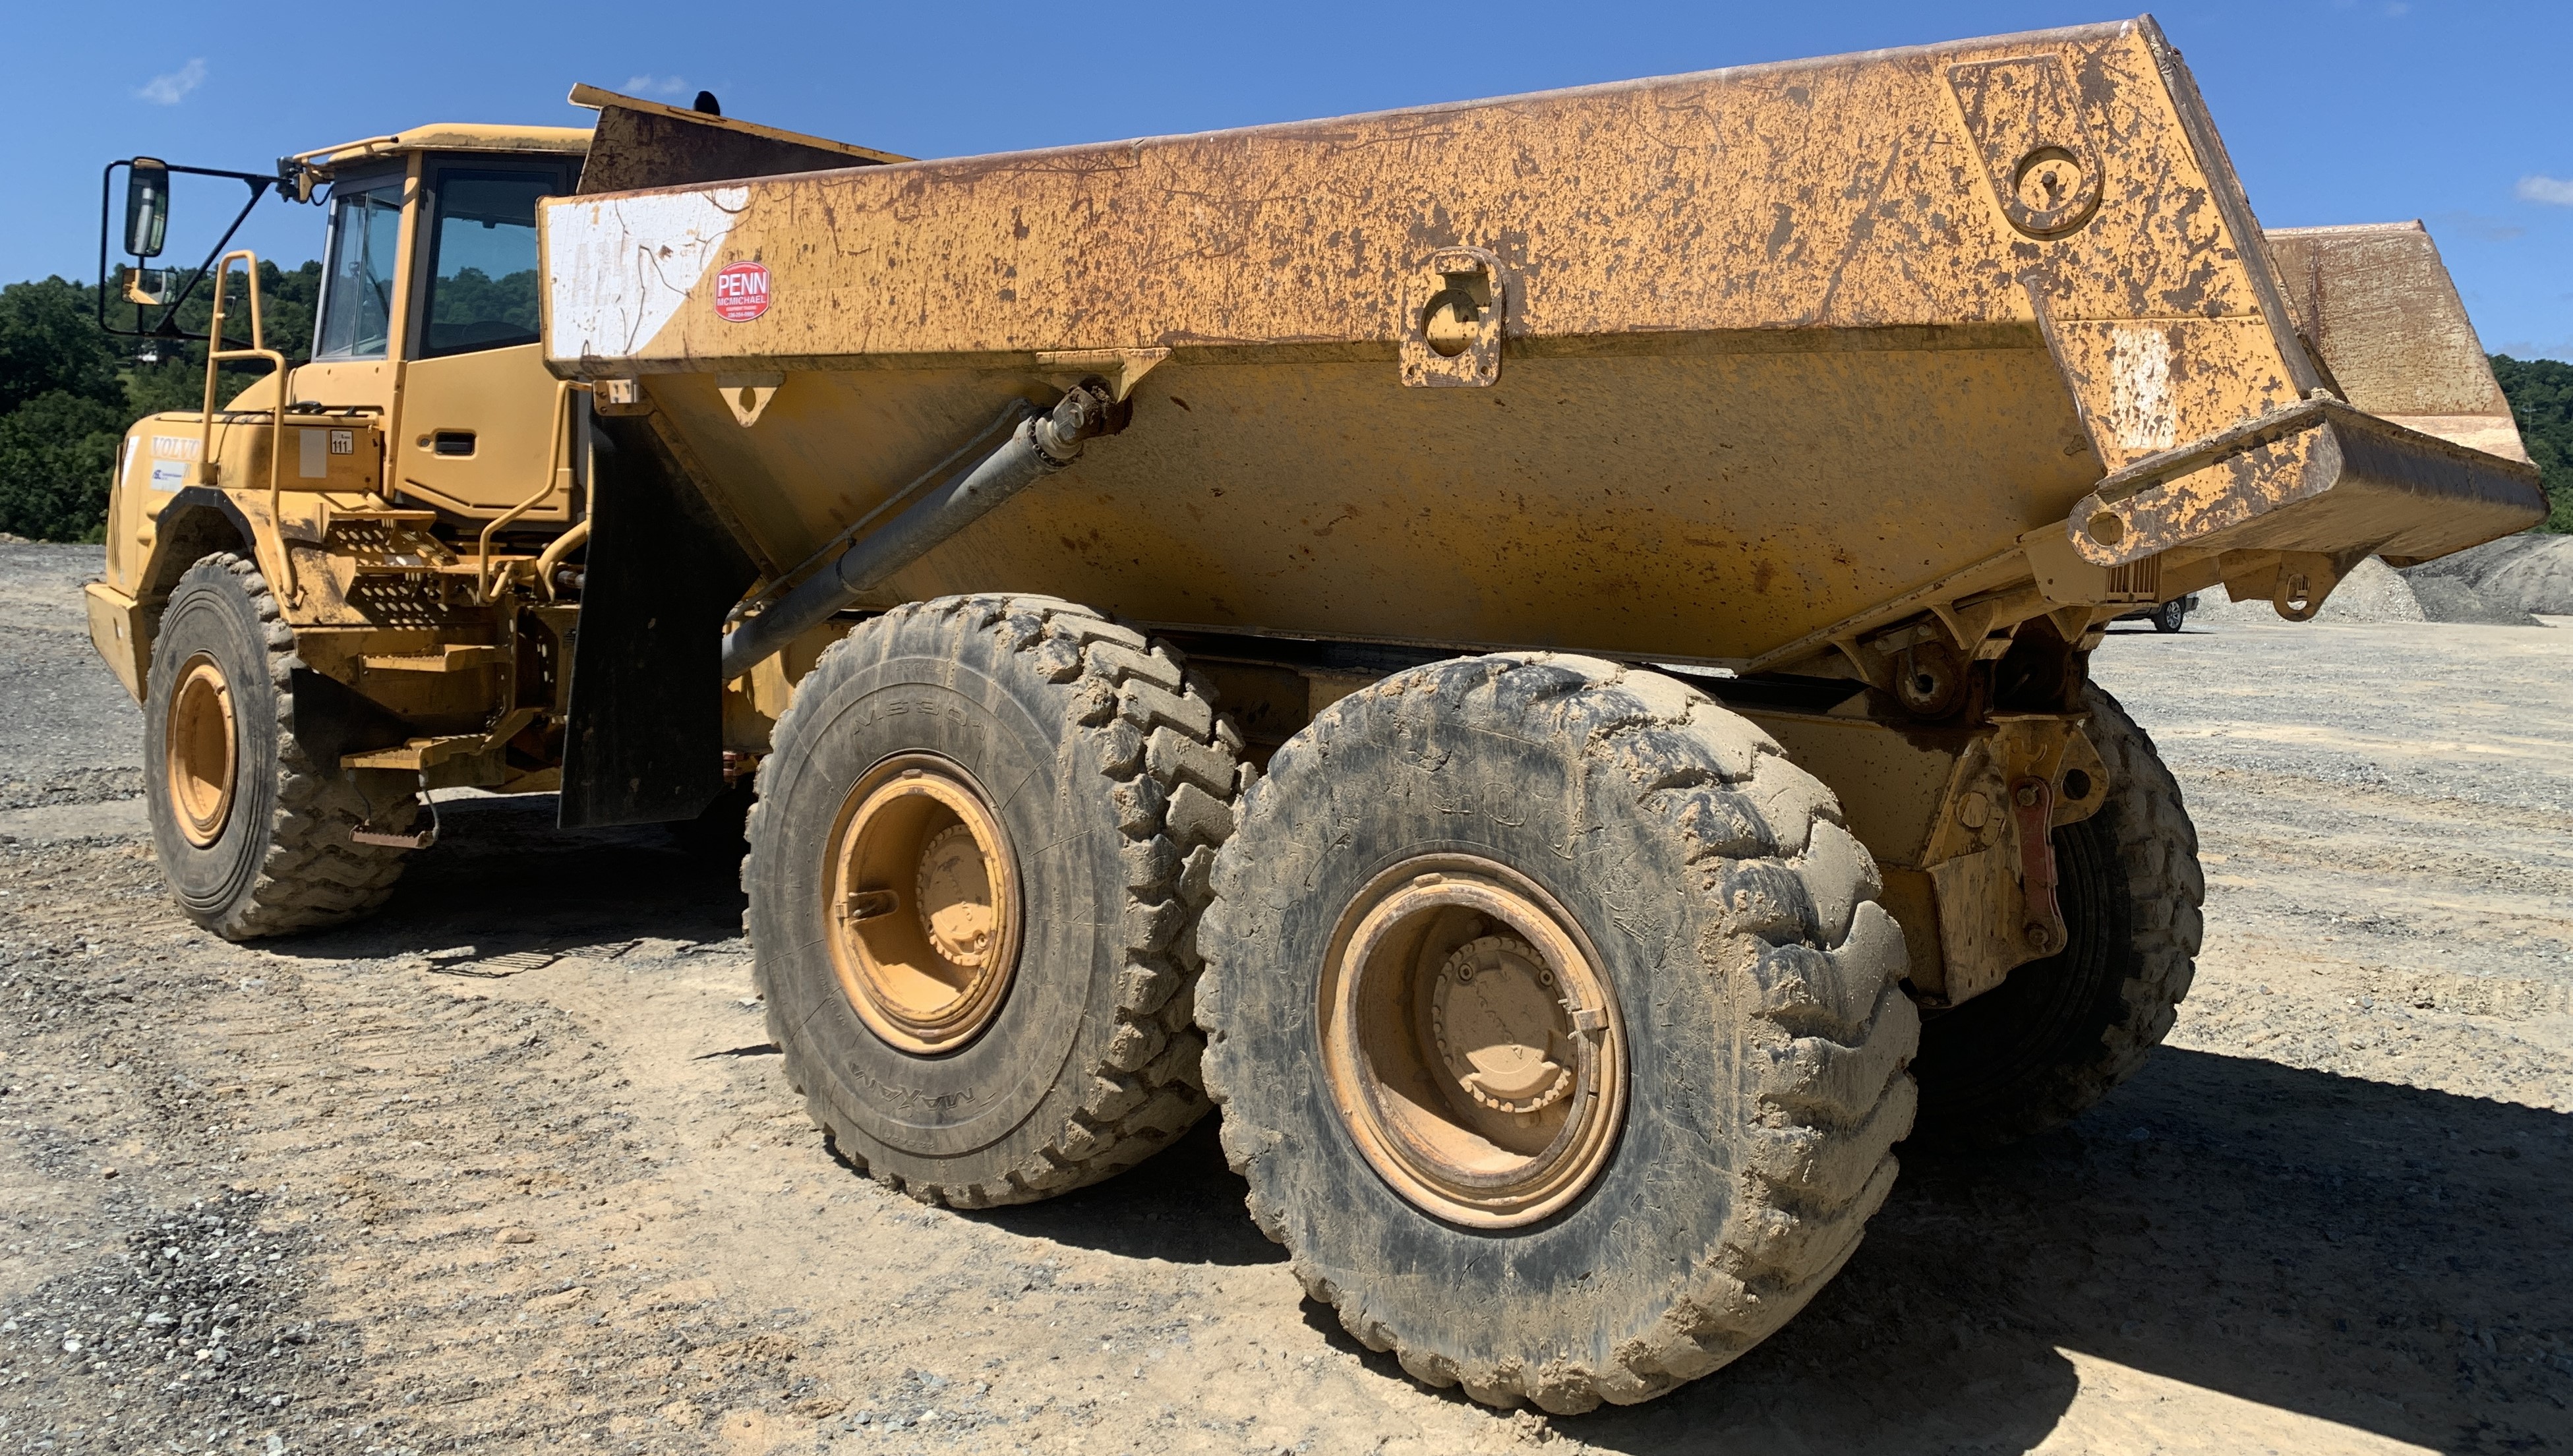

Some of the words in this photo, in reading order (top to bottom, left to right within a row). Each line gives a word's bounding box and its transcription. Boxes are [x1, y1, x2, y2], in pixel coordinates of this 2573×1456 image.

[718, 272, 766, 297] PENN
[717, 295, 766, 306] MCMICHAEL
[152, 437, 200, 459] VOLVO
[333, 440, 347, 453] 111
[847, 1062, 976, 1115] MAXAM
